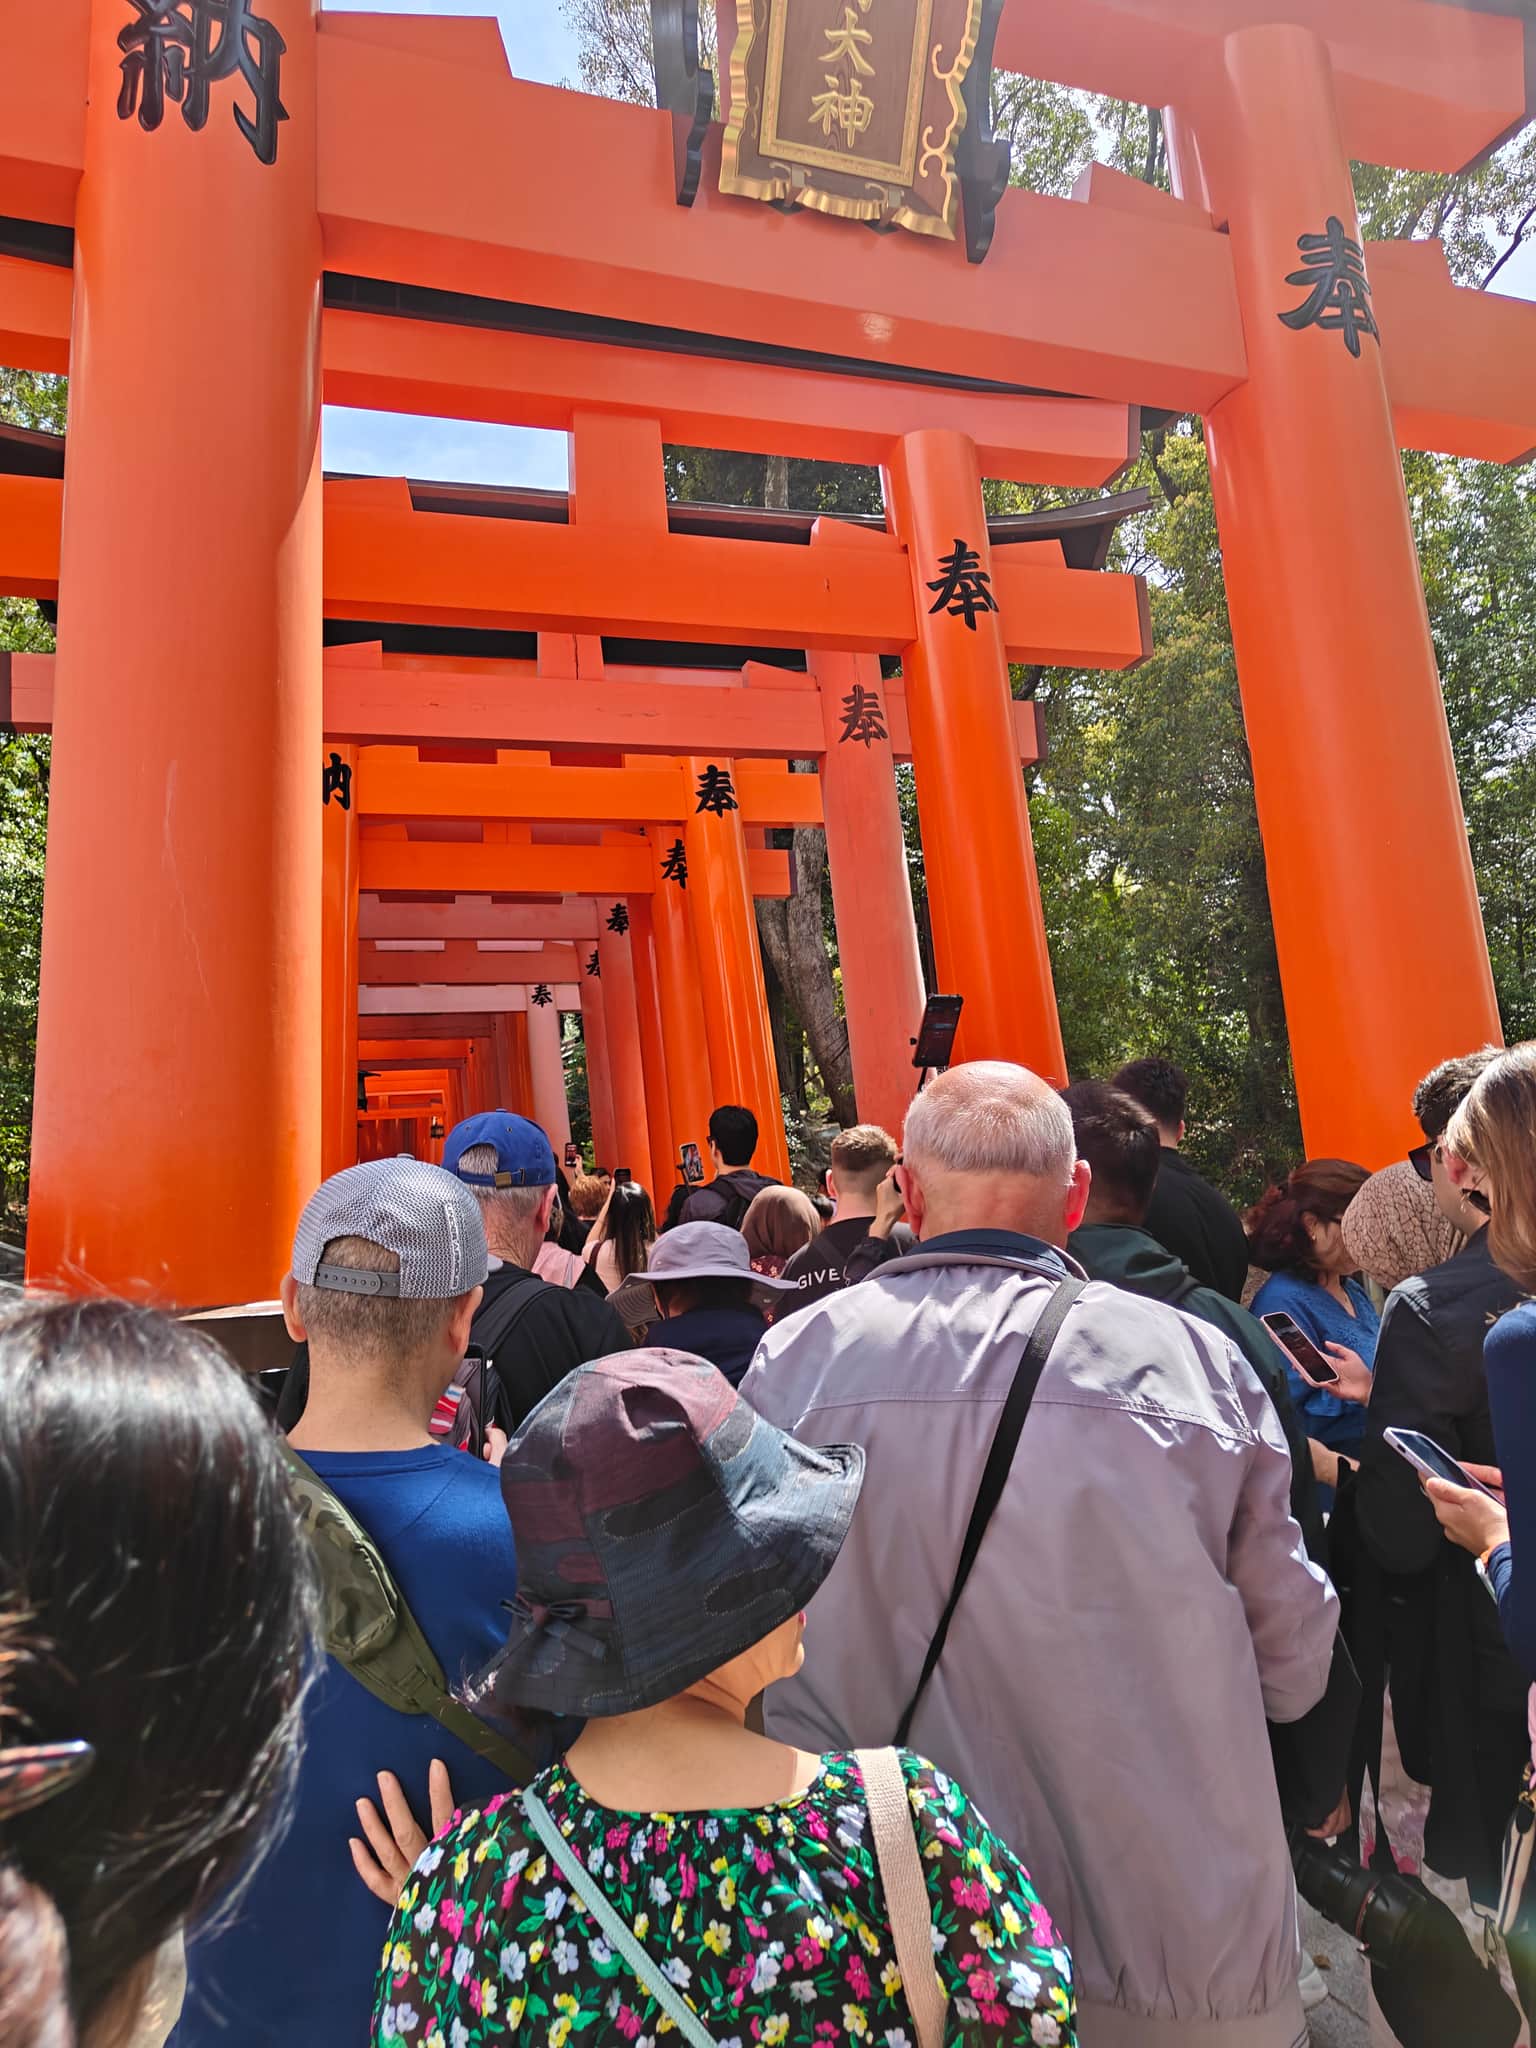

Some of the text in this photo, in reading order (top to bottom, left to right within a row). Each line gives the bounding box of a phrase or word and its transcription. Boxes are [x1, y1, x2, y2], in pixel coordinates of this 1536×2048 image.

[809, 0, 876, 148] 大神
[1277, 215, 1381, 358] 奉
[926, 539, 999, 631] 奉
[838, 684, 888, 748] 奉
[696, 765, 738, 817] 奉
[661, 839, 688, 888] 奉
[606, 903, 629, 935] 奉
[531, 984, 552, 1007] 奉
[799, 1268, 840, 1289] GIVE
